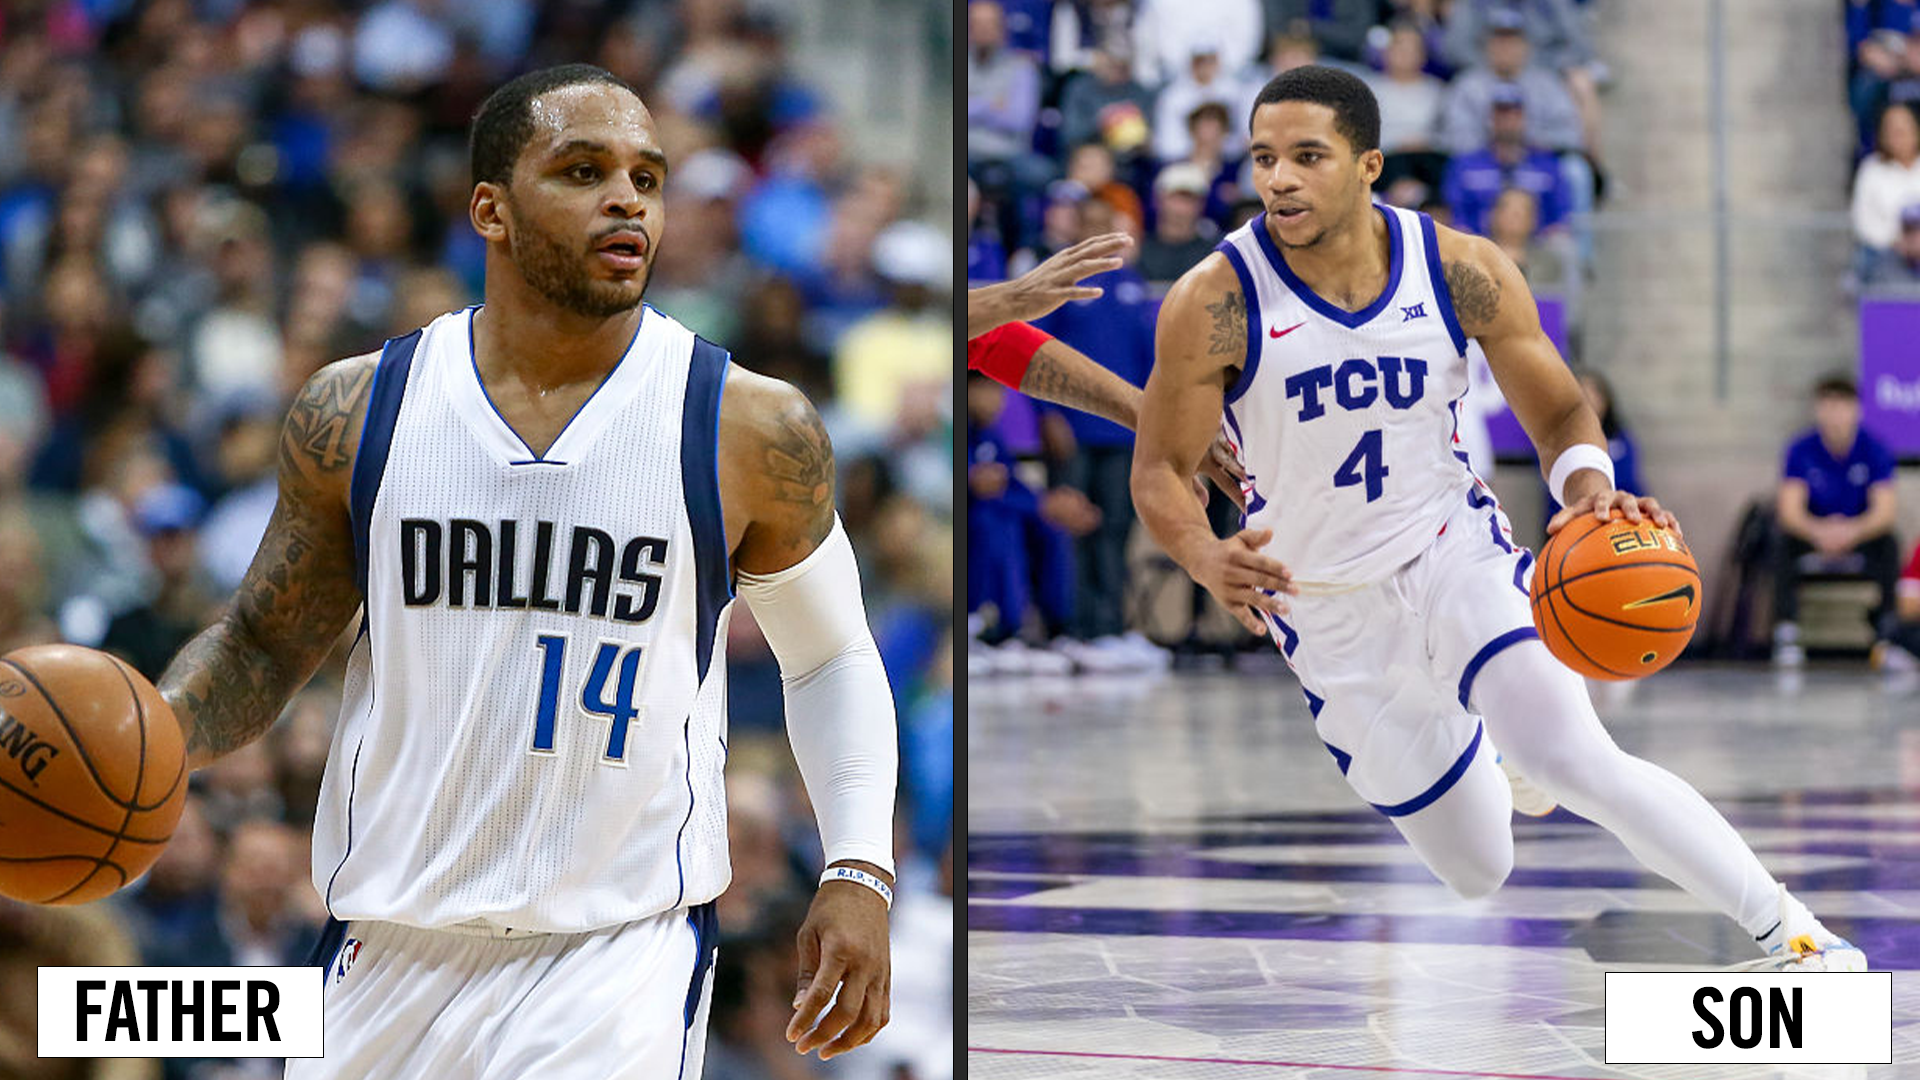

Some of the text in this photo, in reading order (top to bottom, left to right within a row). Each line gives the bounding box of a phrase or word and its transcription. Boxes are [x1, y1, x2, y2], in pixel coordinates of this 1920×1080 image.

[1284, 355, 1429, 423] TCU
[1333, 428, 1390, 504] 4
[399, 518, 669, 626] DALLAS
[530, 631, 646, 766] 14
